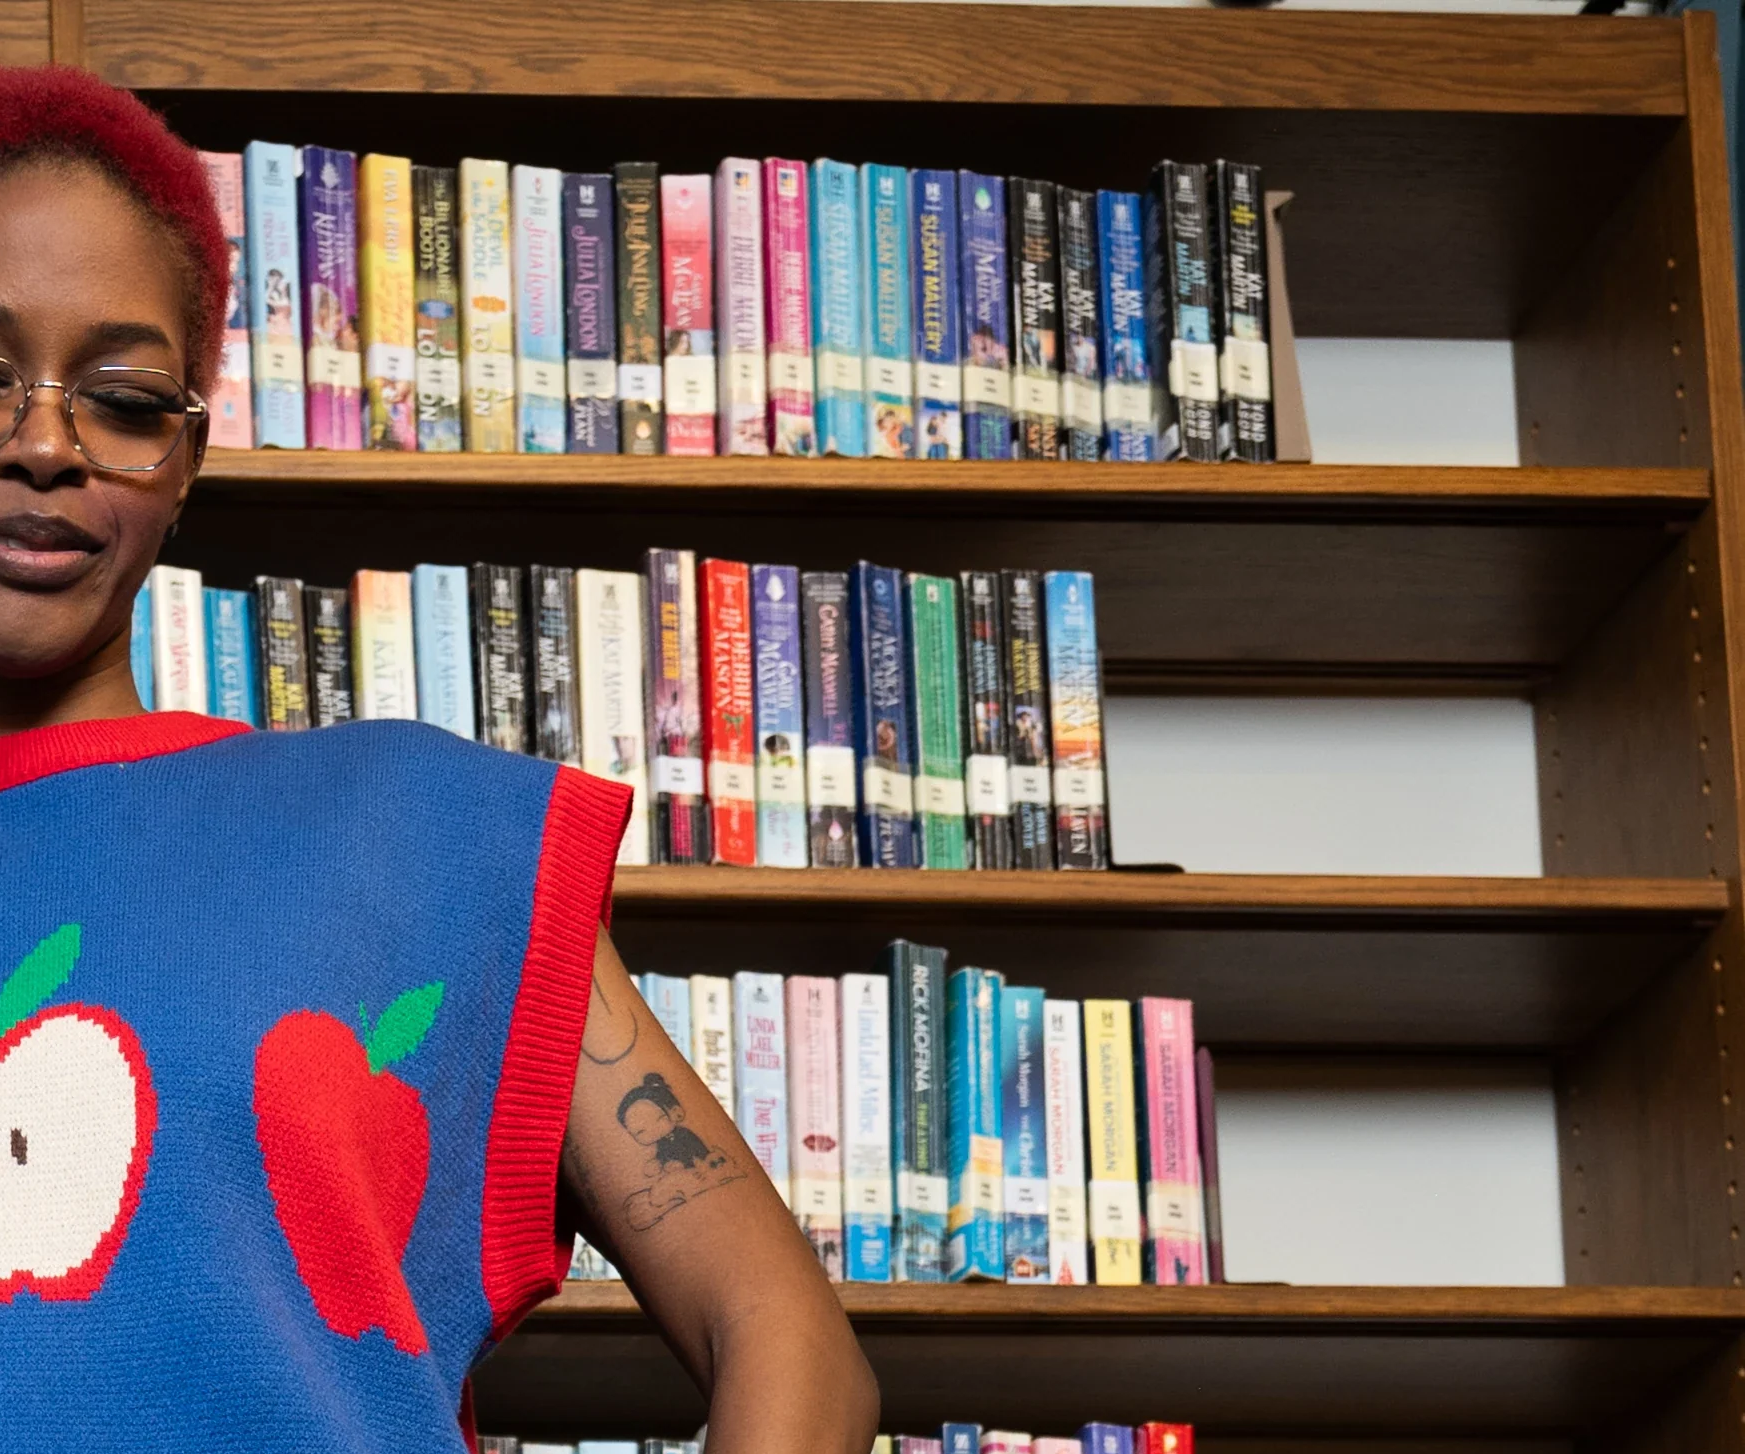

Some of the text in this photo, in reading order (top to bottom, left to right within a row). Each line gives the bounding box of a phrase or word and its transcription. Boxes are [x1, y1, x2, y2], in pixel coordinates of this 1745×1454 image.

[418, 216, 436, 271] BOOTS
[431, 200, 453, 298] BILLIONAIRE
[470, 213, 491, 281] SADDLE
[488, 219, 506, 270] DEVIL
[572, 225, 602, 352] JULIA LONDON
[921, 213, 943, 355] SUSAN MALLERY
[1230, 255, 1248, 309] MARTIN
[1246, 274, 1263, 301] KAT
